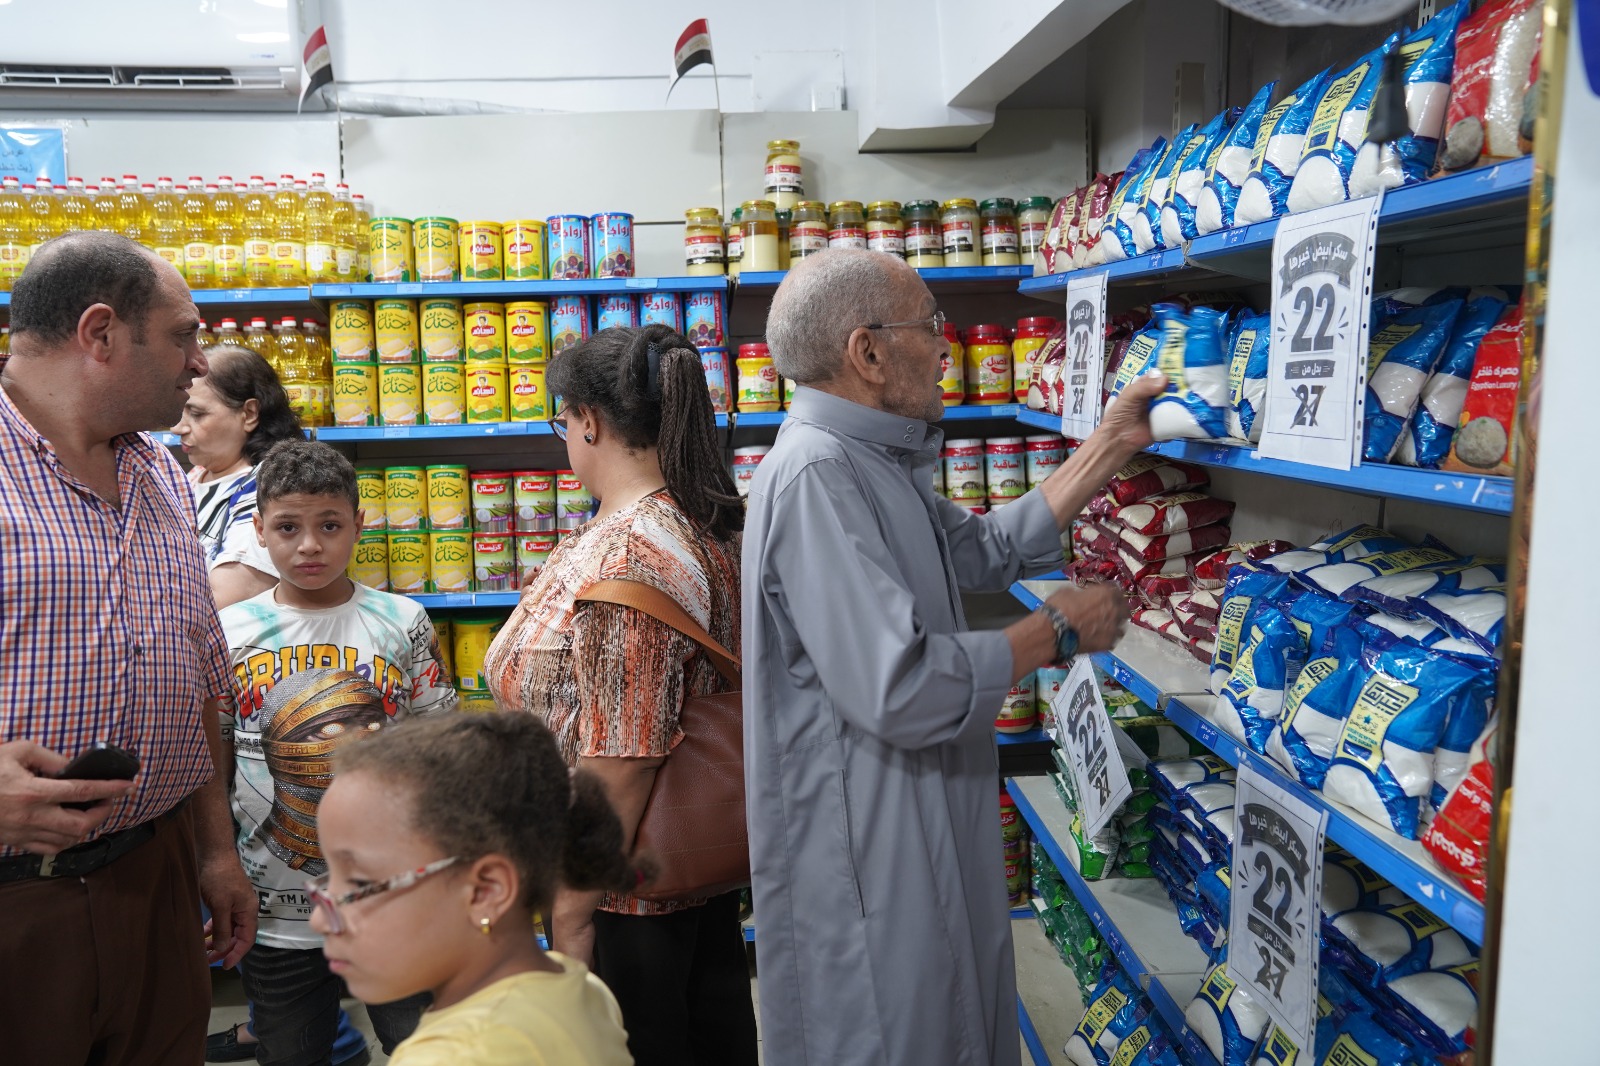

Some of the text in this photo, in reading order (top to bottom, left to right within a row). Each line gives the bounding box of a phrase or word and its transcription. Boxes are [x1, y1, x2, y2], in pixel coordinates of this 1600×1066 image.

[1289, 246, 1310, 270] خيرها
[1332, 242, 1348, 261] سكر
[1290, 283, 1335, 353] 22
[1074, 331, 1088, 370] 22
[1301, 364, 1322, 376] بدل من
[1291, 384, 1325, 427] 27
[1079, 711, 1103, 767] 22
[1093, 765, 1111, 812] 27
[1249, 811, 1268, 831] خيرها
[1252, 851, 1292, 938] 22
[1264, 930, 1283, 950] بدل من
[1255, 945, 1289, 1001] 27
